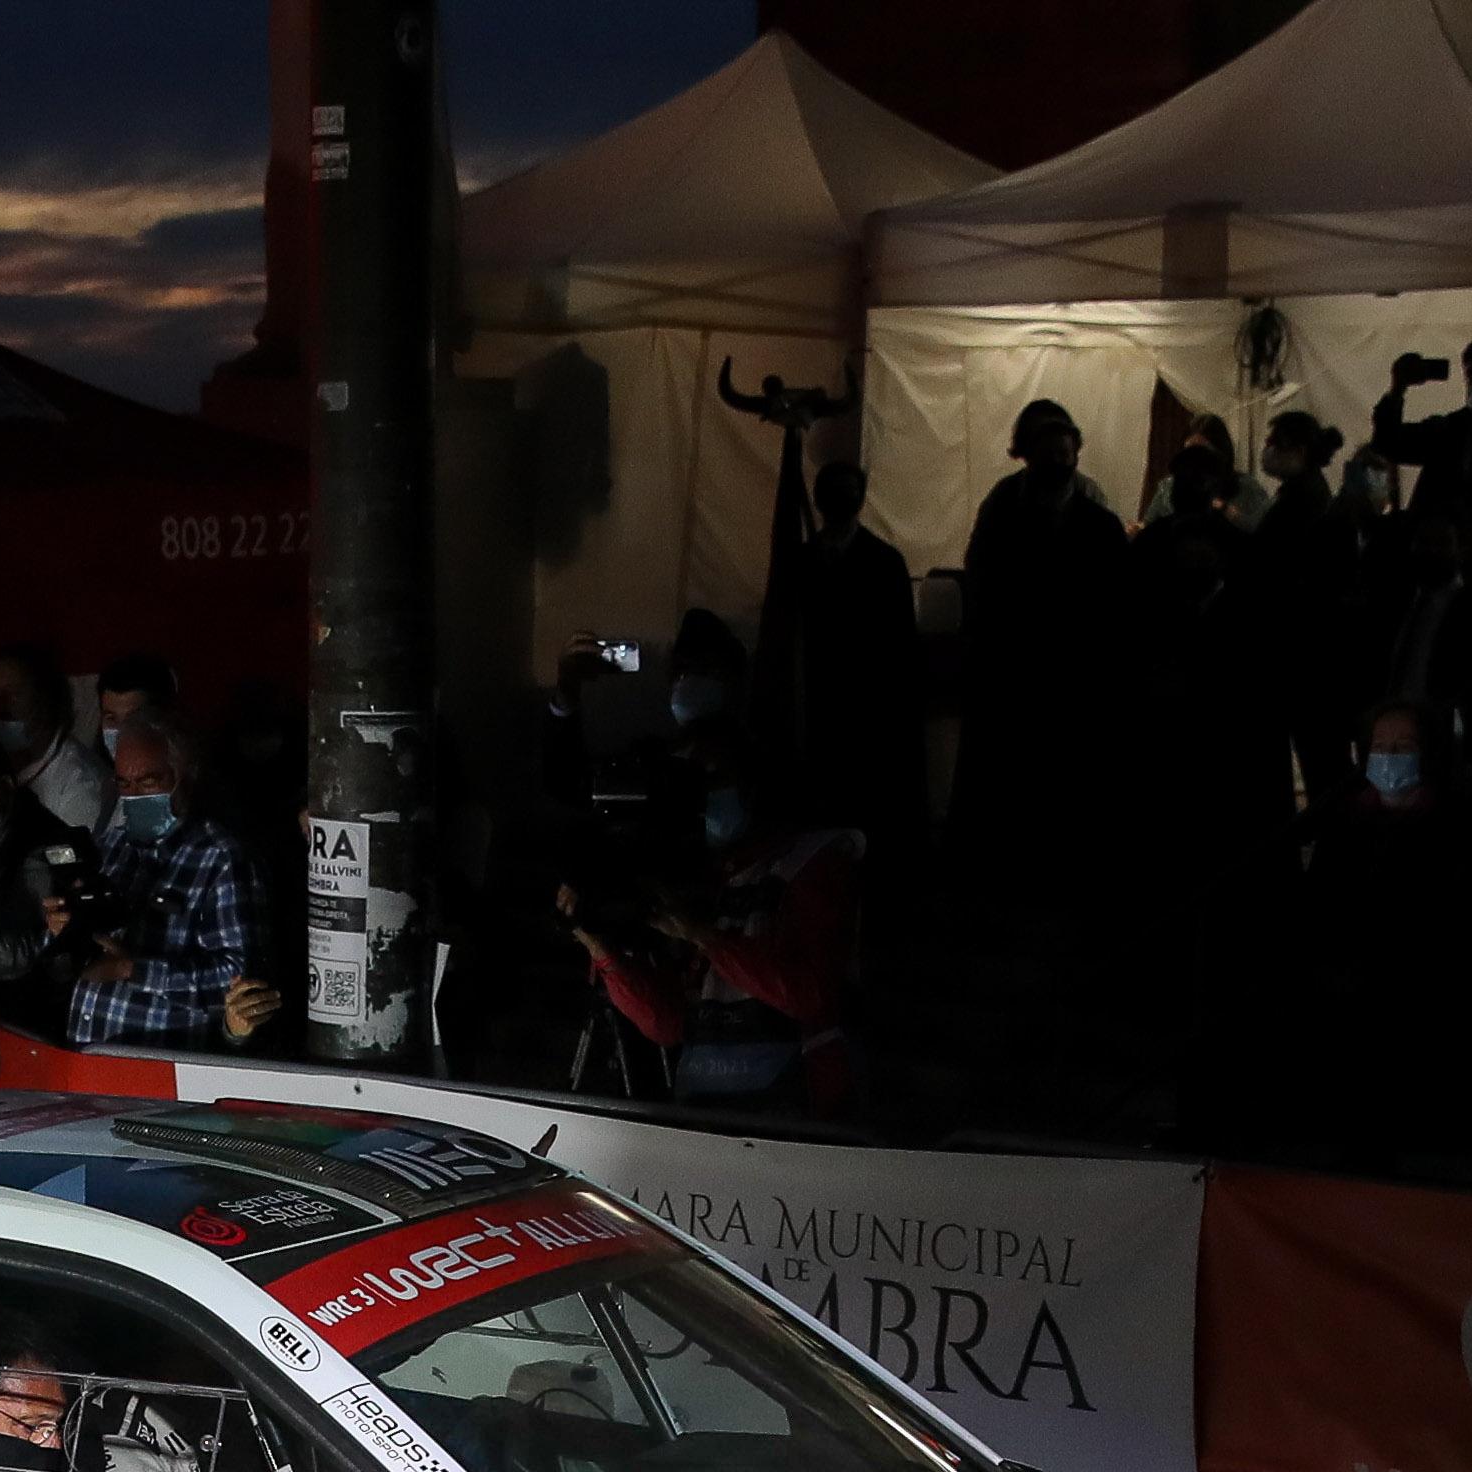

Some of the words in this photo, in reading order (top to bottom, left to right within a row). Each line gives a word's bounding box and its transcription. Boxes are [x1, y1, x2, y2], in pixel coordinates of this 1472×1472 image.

[161, 515, 221, 561] 808
[230, 514, 267, 559] 22
[309, 824, 357, 861] RA
[773, 1196, 1084, 1288] MUNICIPAL
[784, 1257, 811, 1282] DE
[307, 1295, 363, 1328] WRC
[355, 1287, 376, 1307] 3
[268, 1322, 310, 1366] BELL
